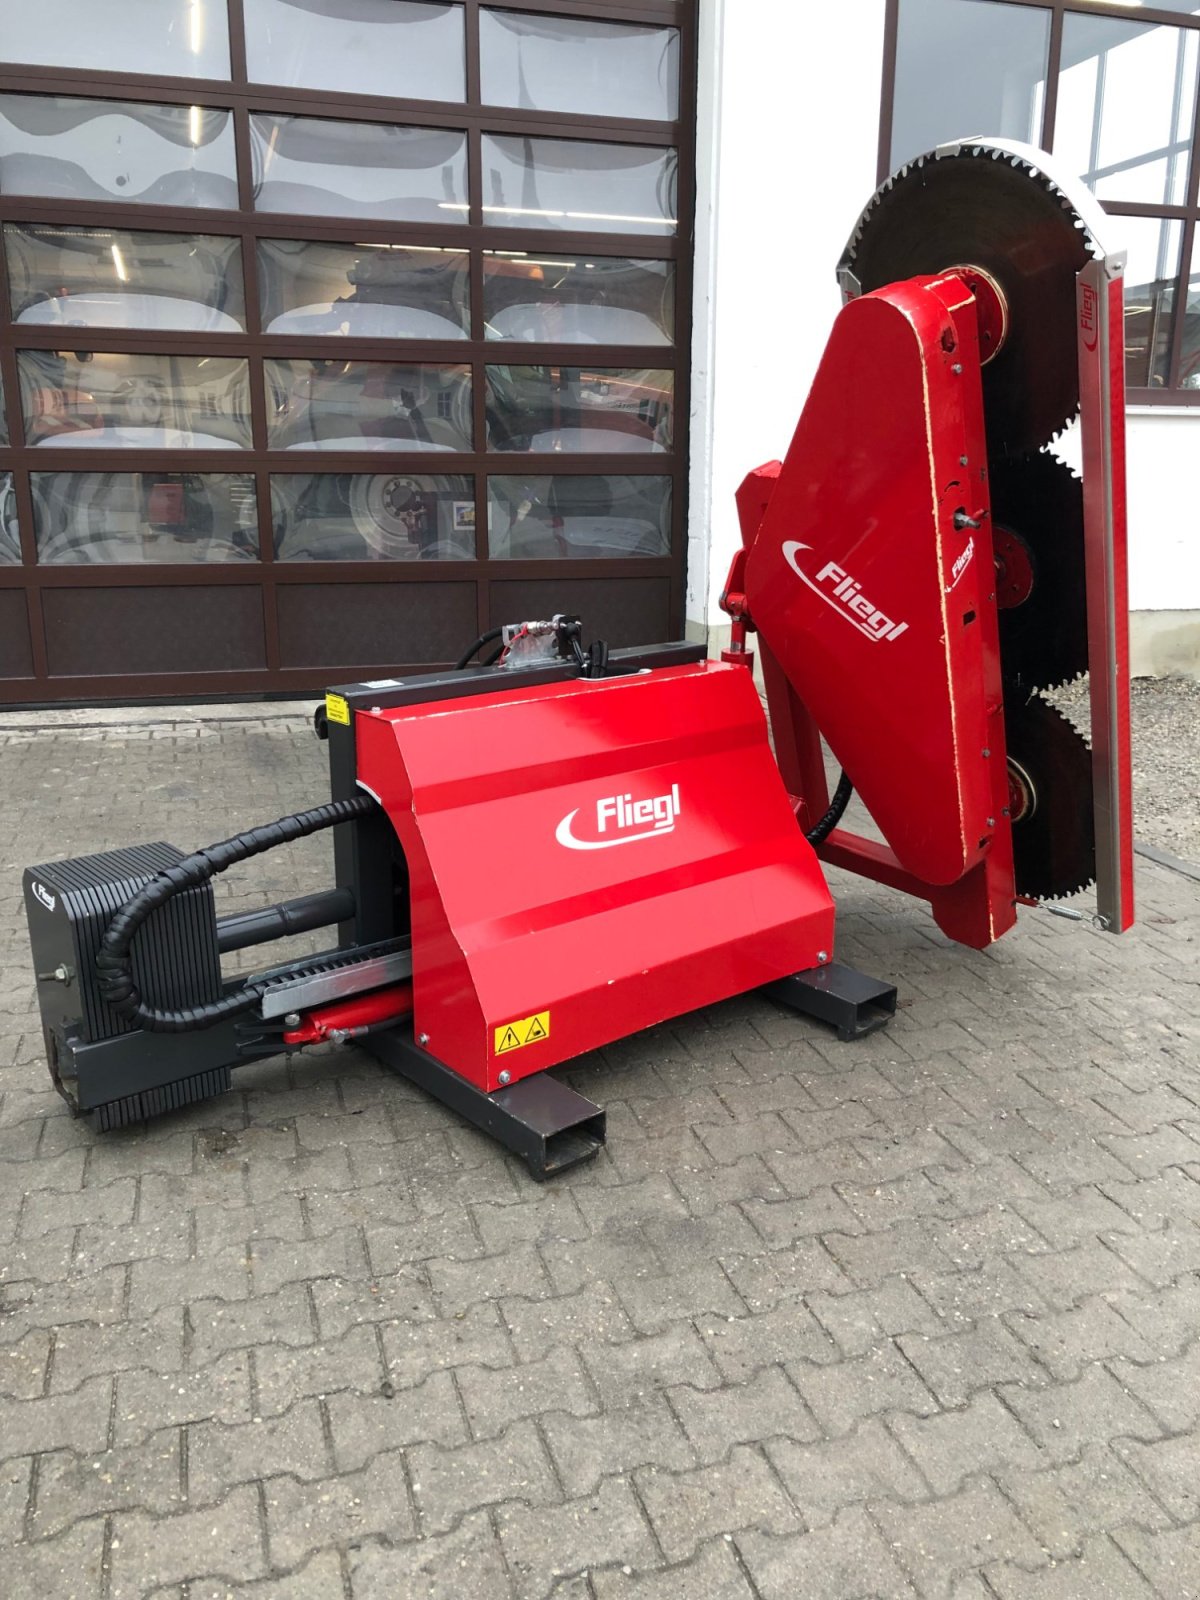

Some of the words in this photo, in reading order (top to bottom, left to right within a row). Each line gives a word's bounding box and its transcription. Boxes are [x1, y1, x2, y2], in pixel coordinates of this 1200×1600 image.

[1080, 282, 1095, 331] Fliegl
[951, 536, 974, 579] Fliegl
[815, 561, 909, 642] Fliegl
[596, 783, 681, 833] Fliegl
